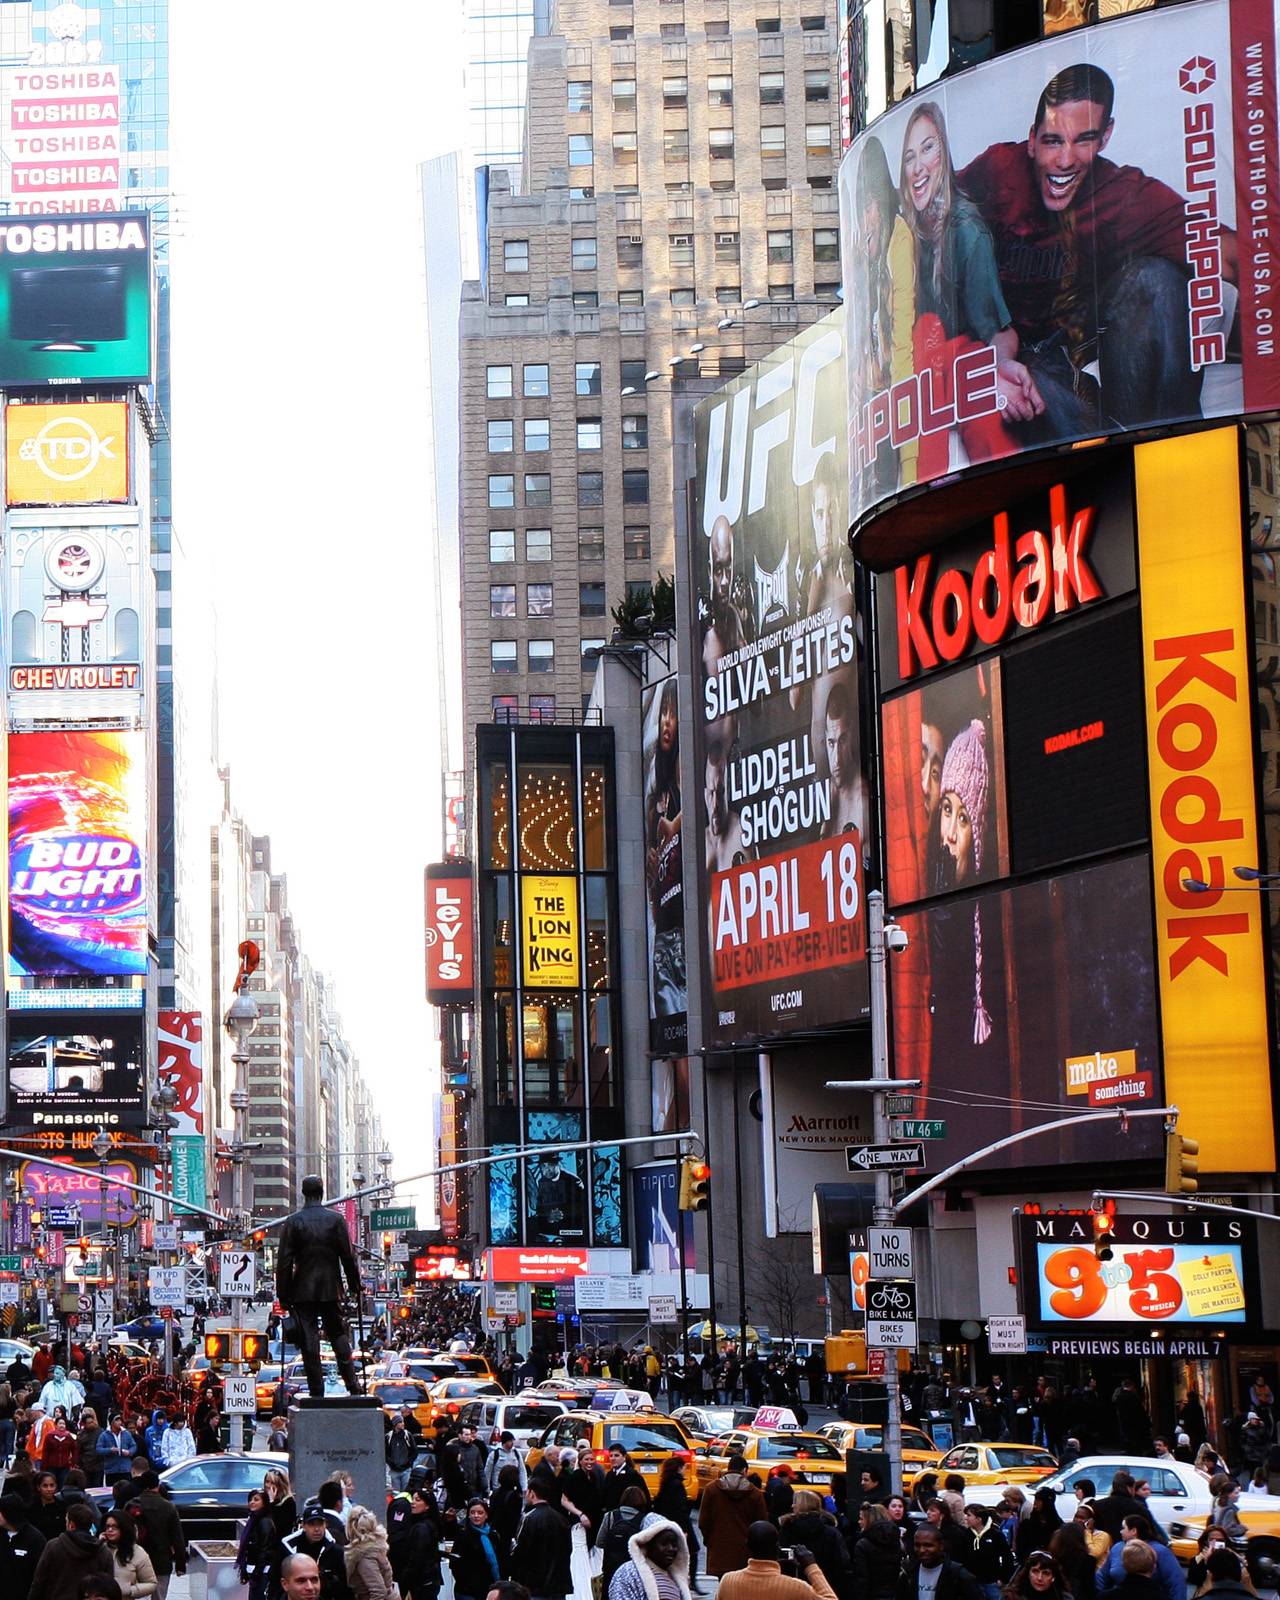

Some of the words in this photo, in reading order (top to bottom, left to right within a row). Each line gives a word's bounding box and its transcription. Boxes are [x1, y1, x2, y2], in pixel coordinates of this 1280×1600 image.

[15, 72, 116, 91] TOSHIBA
[14, 103, 118, 123] TOSHIBA
[15, 135, 116, 153] TOSHIBA
[14, 165, 118, 185] TOSHIBA
[18, 197, 116, 215] TOSHIBA
[1244, 42, 1274, 356] WWW.SOUTHPOLE-USA.COM
[1183, 101, 1225, 370] SOUTHPOLE
[48, 377, 81, 385] TOSHIBA
[703, 331, 842, 537] UFC
[40, 436, 115, 459] TDK
[895, 484, 1103, 679] Kodak
[783, 607, 832, 641] CHAMPIONSHIP
[11, 667, 136, 689] CHEVROLET
[705, 657, 771, 721] SILVA
[779, 615, 854, 687] LEITES
[1044, 720, 1104, 755] KODAK.COM
[730, 734, 816, 801] LIDDELL
[741, 778, 832, 848] SHOGUN
[1153, 628, 1250, 982] Kodak
[28, 842, 131, 870] BUD
[11, 867, 143, 897] LIGHT
[534, 897, 565, 911] THE
[716, 857, 810, 950] APRIL
[821, 843, 859, 922] 18
[529, 916, 571, 942] LION
[529, 946, 573, 972] KING
[715, 951, 741, 983] LIVE
[745, 945, 762, 970] ON
[767, 920, 862, 969] PAY-PER-VIEW
[771, 990, 802, 1012] UFC.COM
[1069, 1053, 1117, 1088] make
[1095, 1079, 1146, 1100] something
[33, 1112, 119, 1125] Panasonic
[787, 1115, 860, 1132] Marriott
[906, 1124, 916, 1137] W
[918, 1124, 931, 1137] 46
[934, 1123, 942, 1131] ST
[859, 1152, 881, 1163] ONE
[891, 1151, 914, 1162] WAY
[27, 1172, 130, 1194] YAHOO!
[377, 1215, 410, 1227] Broadway
[882, 1235, 900, 1249] NO
[223, 1254, 239, 1264] NO
[873, 1253, 910, 1267] TURNS
[225, 1283, 250, 1292] TURN
[1045, 1246, 1109, 1319] 9
[1100, 1262, 1133, 1288] to
[1124, 1247, 1184, 1319] 5
[870, 1310, 888, 1319] BIKE
[891, 1310, 914, 1319] LANE
[1150, 1301, 1176, 1311] MUSICAL
[880, 1325, 904, 1333] BIKES
[881, 1335, 903, 1344] ONLY
[1052, 1340, 1120, 1355] PREVIEWS
[1125, 1340, 1165, 1355] BEGIN
[1170, 1341, 1209, 1355] APRIL
[1214, 1341, 1220, 1354] 7
[233, 1382, 247, 1393] NO
[226, 1396, 254, 1406] TURNS
